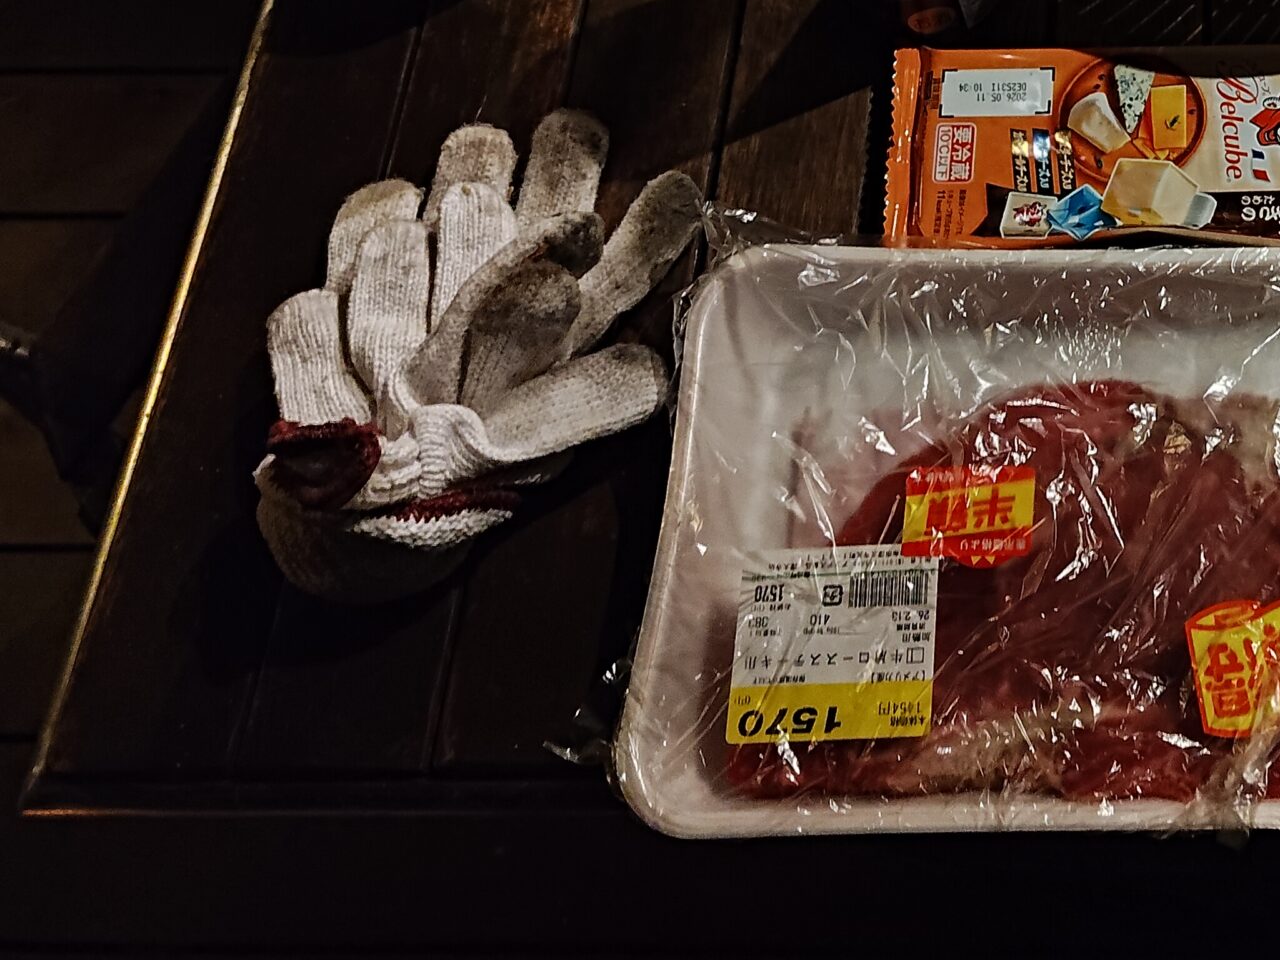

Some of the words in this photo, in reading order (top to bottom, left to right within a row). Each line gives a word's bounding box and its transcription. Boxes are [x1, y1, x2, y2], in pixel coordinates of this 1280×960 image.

[1216, 75, 1258, 179] Belcube
[950, 126, 973, 181] 要冷蔵
[923, 486, 1016, 536] 半額
[754, 584, 784, 601] 1570
[810, 614, 830, 625] 410
[738, 706, 842, 736] 1570
